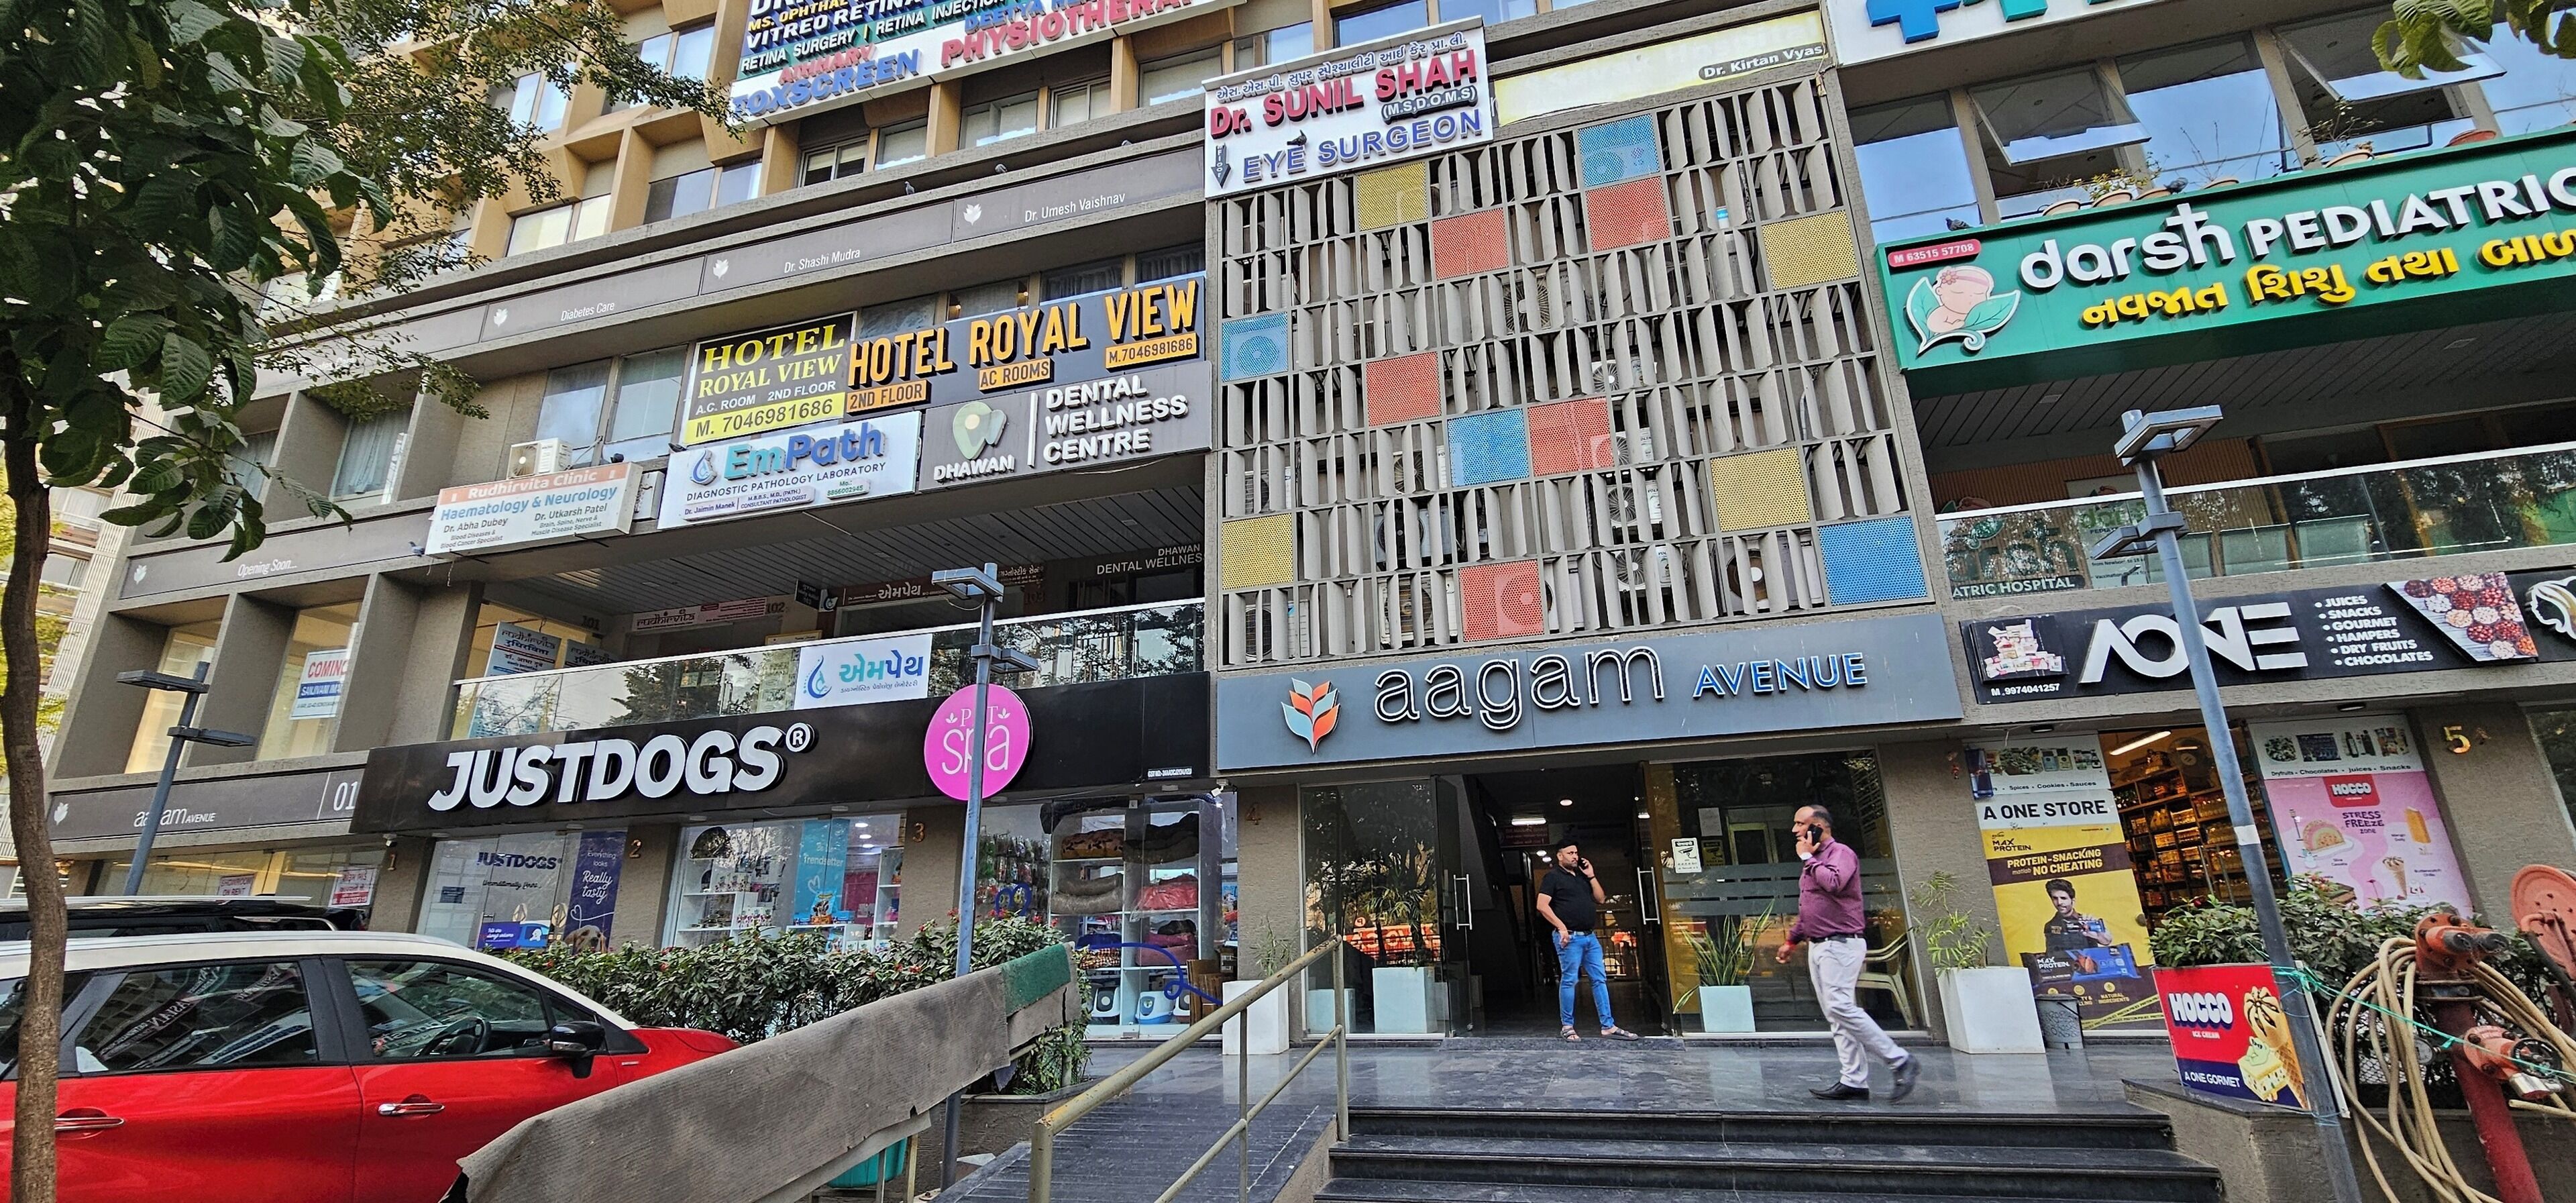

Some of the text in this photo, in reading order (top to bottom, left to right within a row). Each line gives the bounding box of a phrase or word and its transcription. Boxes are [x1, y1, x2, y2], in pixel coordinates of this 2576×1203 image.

[747, 14, 828, 49] VITREO
[748, 17, 774, 32] MS.
[741, 11, 924, 71] RETINA SURGERY RETINA
[1379, 47, 1405, 63] આઈ
[1409, 40, 1427, 56] કેર
[1704, 46, 1823, 79] Dr. Kirtan Vyas
[1210, 50, 1478, 136] Dr. SUNIL SHAH
[1243, 109, 1481, 180] EYE SURGEON
[1024, 189, 1126, 223] Dr. Umesh Vaishnav
[1892, 242, 1975, 264] M 63515 57708
[2019, 202, 2236, 289] darsh
[784, 248, 860, 274] Dr. Shashi Mudra
[2082, 280, 2230, 327] નવજાત
[2366, 246, 2461, 284] તથા
[561, 301, 615, 321] Diabetes Care
[848, 280, 1197, 387] HOTEL ROYAL VIEW
[701, 324, 845, 374] HOTEL
[1108, 337, 1193, 363] M.7046981686
[698, 354, 843, 399] ROYAL VIEW
[980, 362, 1049, 388] AC ROOMS
[696, 381, 836, 415] A.C. ROOM 2ND FLOOR
[850, 383, 923, 409] 2ND FLOOR
[1046, 374, 1148, 410] DENTAL
[696, 399, 833, 437] M. 7046981686
[1045, 395, 1187, 435] WELLNESS
[725, 422, 883, 480] EmPath
[1043, 428, 1150, 464] CENTRE
[934, 454, 1015, 481] DHAWAN
[468, 470, 597, 501] Rudhirvita Clinic
[687, 462, 886, 502] DIAGNOSTIC PATHOLOGY LABORATORY
[441, 486, 618, 521] Haematology & Neurology
[535, 503, 608, 521] Dr. Utkarsh Patel
[694, 504, 714, 514] Jaimin
[715, 501, 735, 511] Manek
[741, 494, 807, 509] CONSULTANT PATHOLOGIST
[443, 517, 508, 533] Dr. Abha Dubey
[574, 521, 602, 532] Specialist
[1158, 544, 1200, 556] DHAWAN
[237, 562, 269, 578] Opening
[1097, 562, 1142, 575] DENTAL
[1999, 577, 2076, 594] HOSPITAL
[2325, 595, 2367, 607] JUICES
[2328, 606, 2382, 619] SNACKS
[2332, 617, 2398, 631] GOURMET
[2336, 629, 2400, 643] HAMPERS
[2341, 639, 2417, 654] DRY FRUITS
[2344, 651, 2434, 666] CHOCOLATES
[839, 649, 923, 683] એમપેથ
[1374, 645, 1868, 730] aagam AVENUE
[960, 706, 998, 727] PT
[2443, 725, 2471, 754] 5
[2332, 783, 2371, 796] HOCCO
[133, 780, 358, 827] aaam AVENUE 01
[1984, 800, 2108, 821] A ONE STORE
[2343, 810, 2382, 819] STRESS
[914, 821, 924, 843] 3
[2345, 819, 2385, 828] FREEZE
[629, 839, 641, 858] 2
[2033, 866, 2048, 876] NO
[2050, 859, 2103, 874] CHEATING
[582, 870, 612, 890] Really
[582, 886, 607, 904] tasty
[2169, 992, 2233, 1025] HOCCO
[2185, 1071, 2241, 1088] A ONE GORMET
